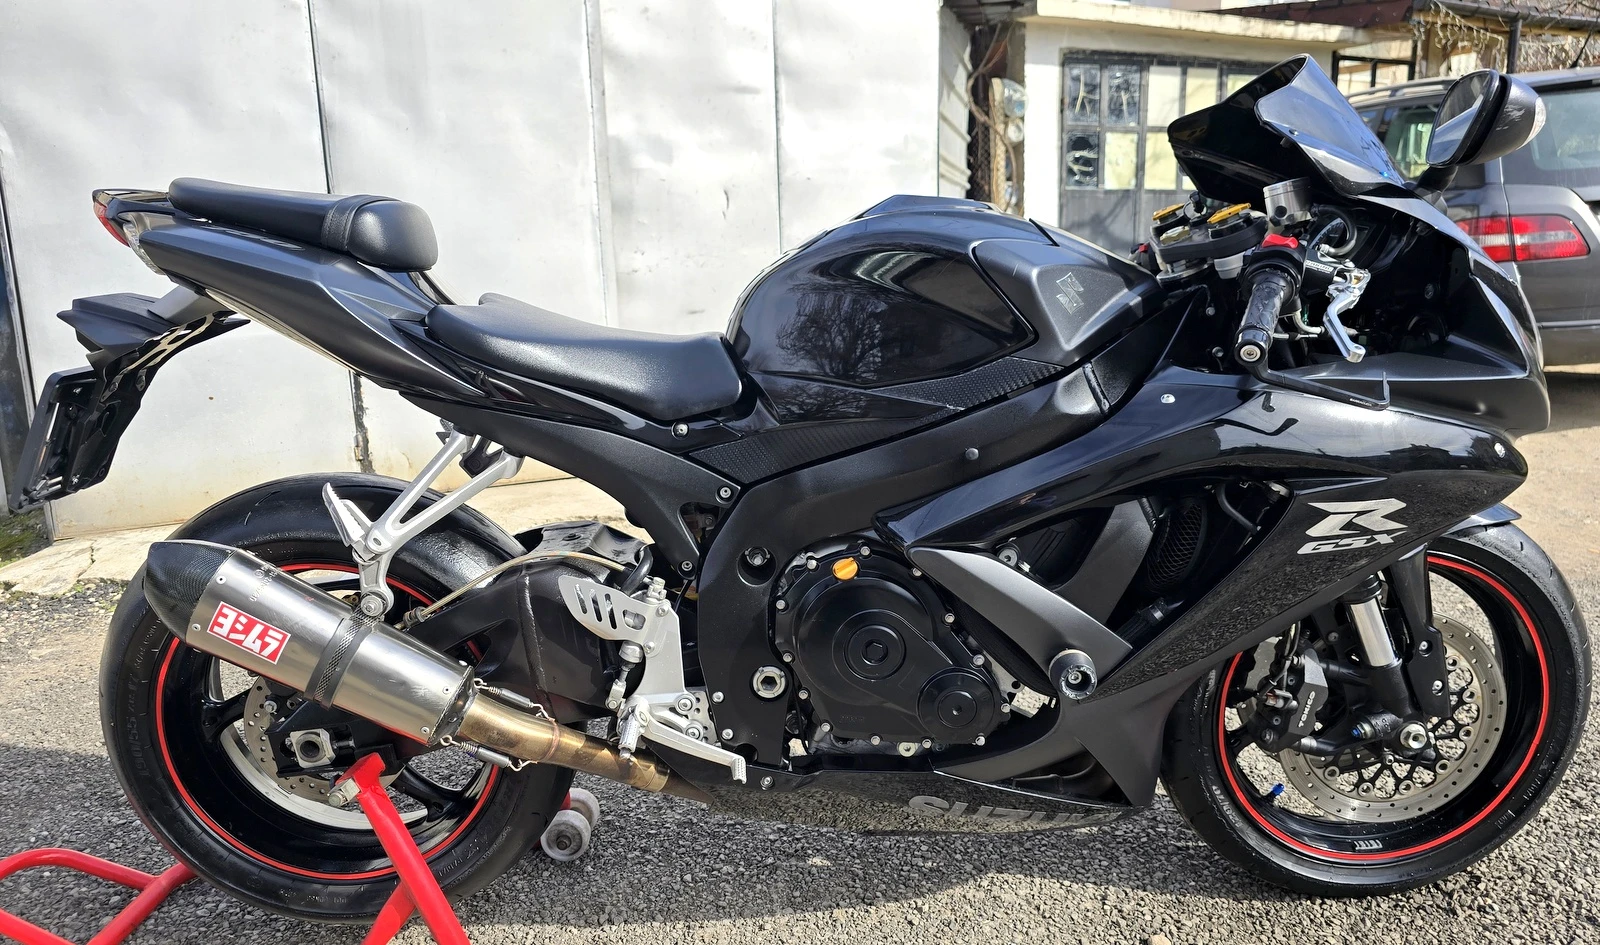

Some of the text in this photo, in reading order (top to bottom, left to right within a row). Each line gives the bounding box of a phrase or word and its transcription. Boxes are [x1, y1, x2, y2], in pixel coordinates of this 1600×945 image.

[1305, 498, 1408, 537] R
[1297, 531, 1407, 554] GSX
[212, 606, 283, 658] ヨシムラ
[1298, 691, 1316, 727] TOKICO
